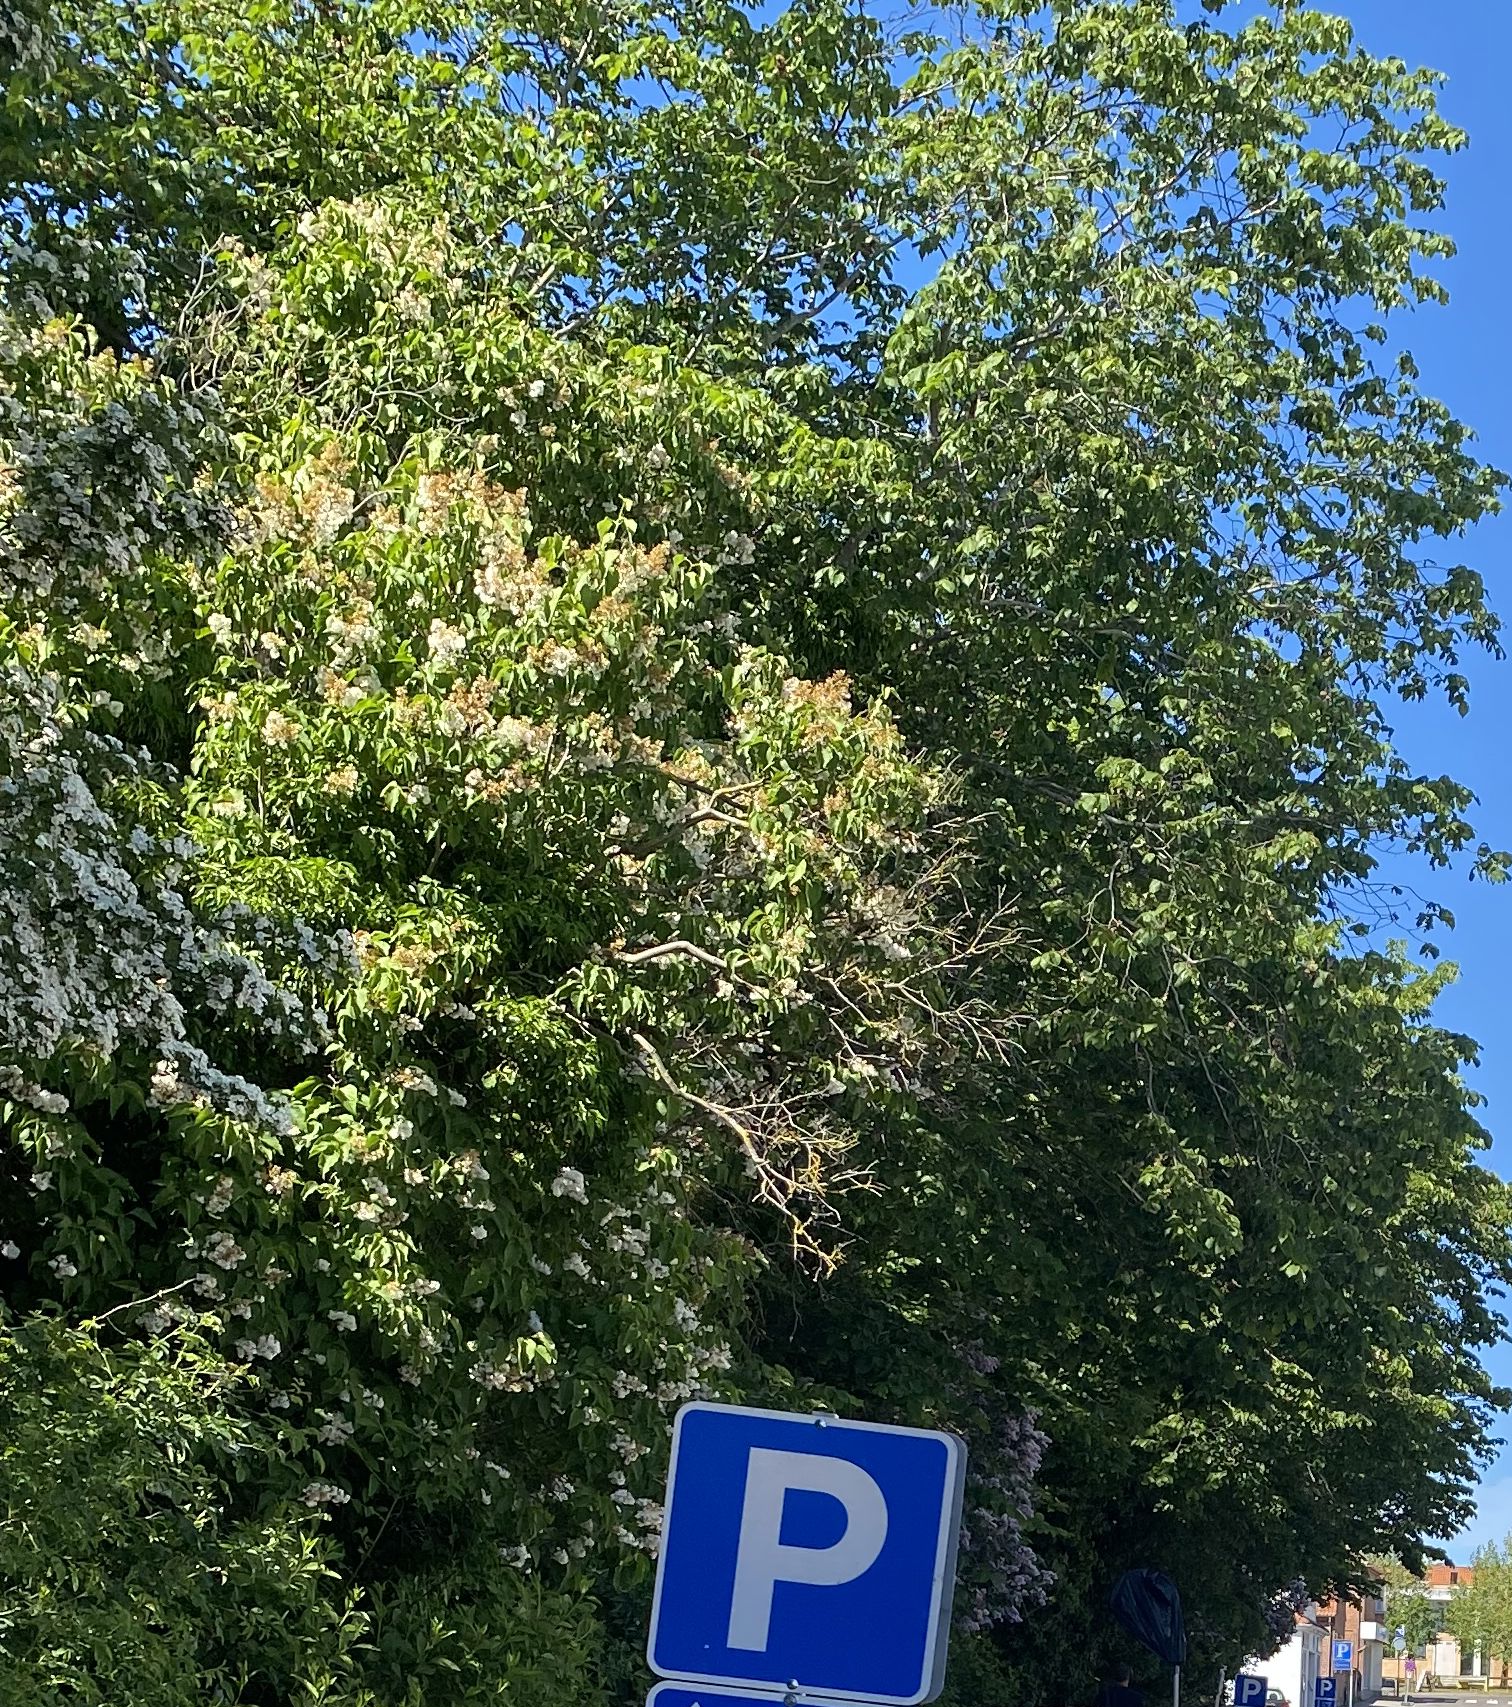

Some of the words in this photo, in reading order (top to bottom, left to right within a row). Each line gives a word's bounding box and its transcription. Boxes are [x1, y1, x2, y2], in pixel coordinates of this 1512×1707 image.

[727, 1447, 888, 1652] P
[1336, 1643, 1349, 1658] P
[1242, 1679, 1262, 1703] P
[1321, 1680, 1333, 1697] P
